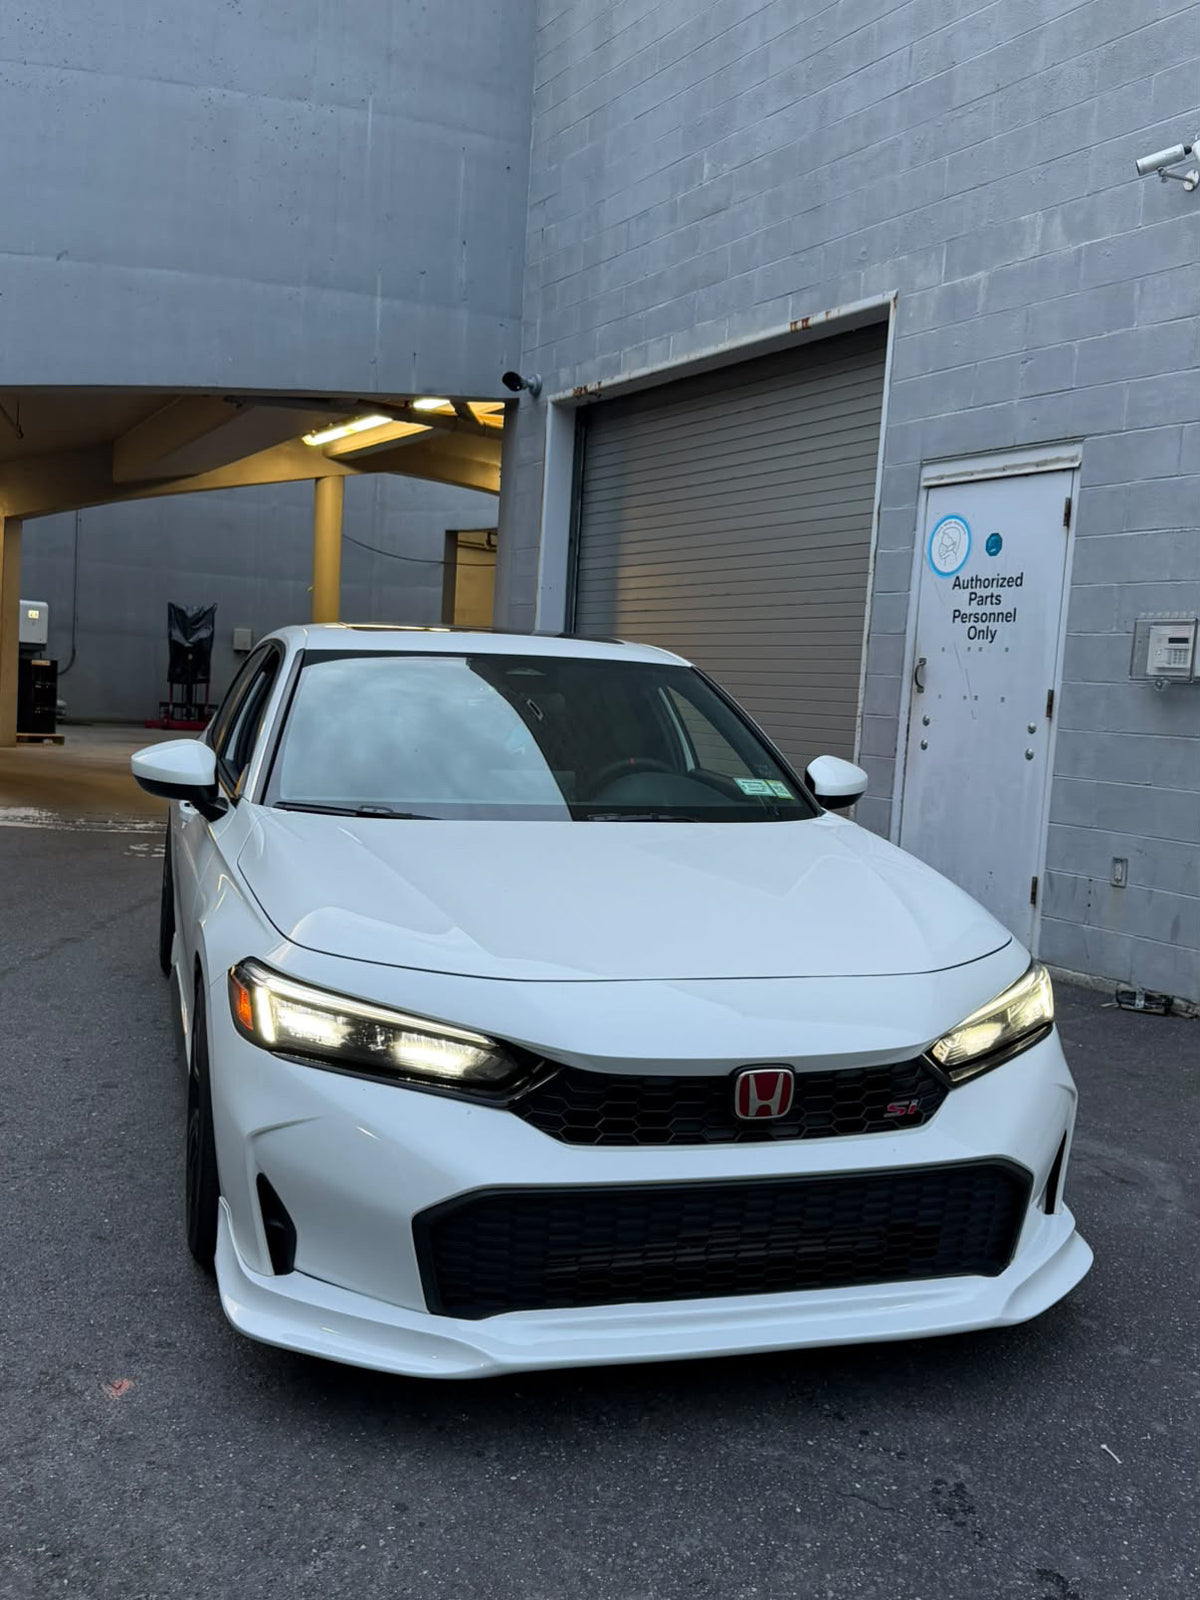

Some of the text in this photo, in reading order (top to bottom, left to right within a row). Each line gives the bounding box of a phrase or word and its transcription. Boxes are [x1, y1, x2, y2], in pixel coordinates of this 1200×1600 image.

[952, 572, 1024, 590] Authorized
[968, 592, 1002, 606] Parts
[952, 607, 1017, 624] Personnel
[967, 625, 998, 644] Only
[884, 1099, 919, 1118] Si
